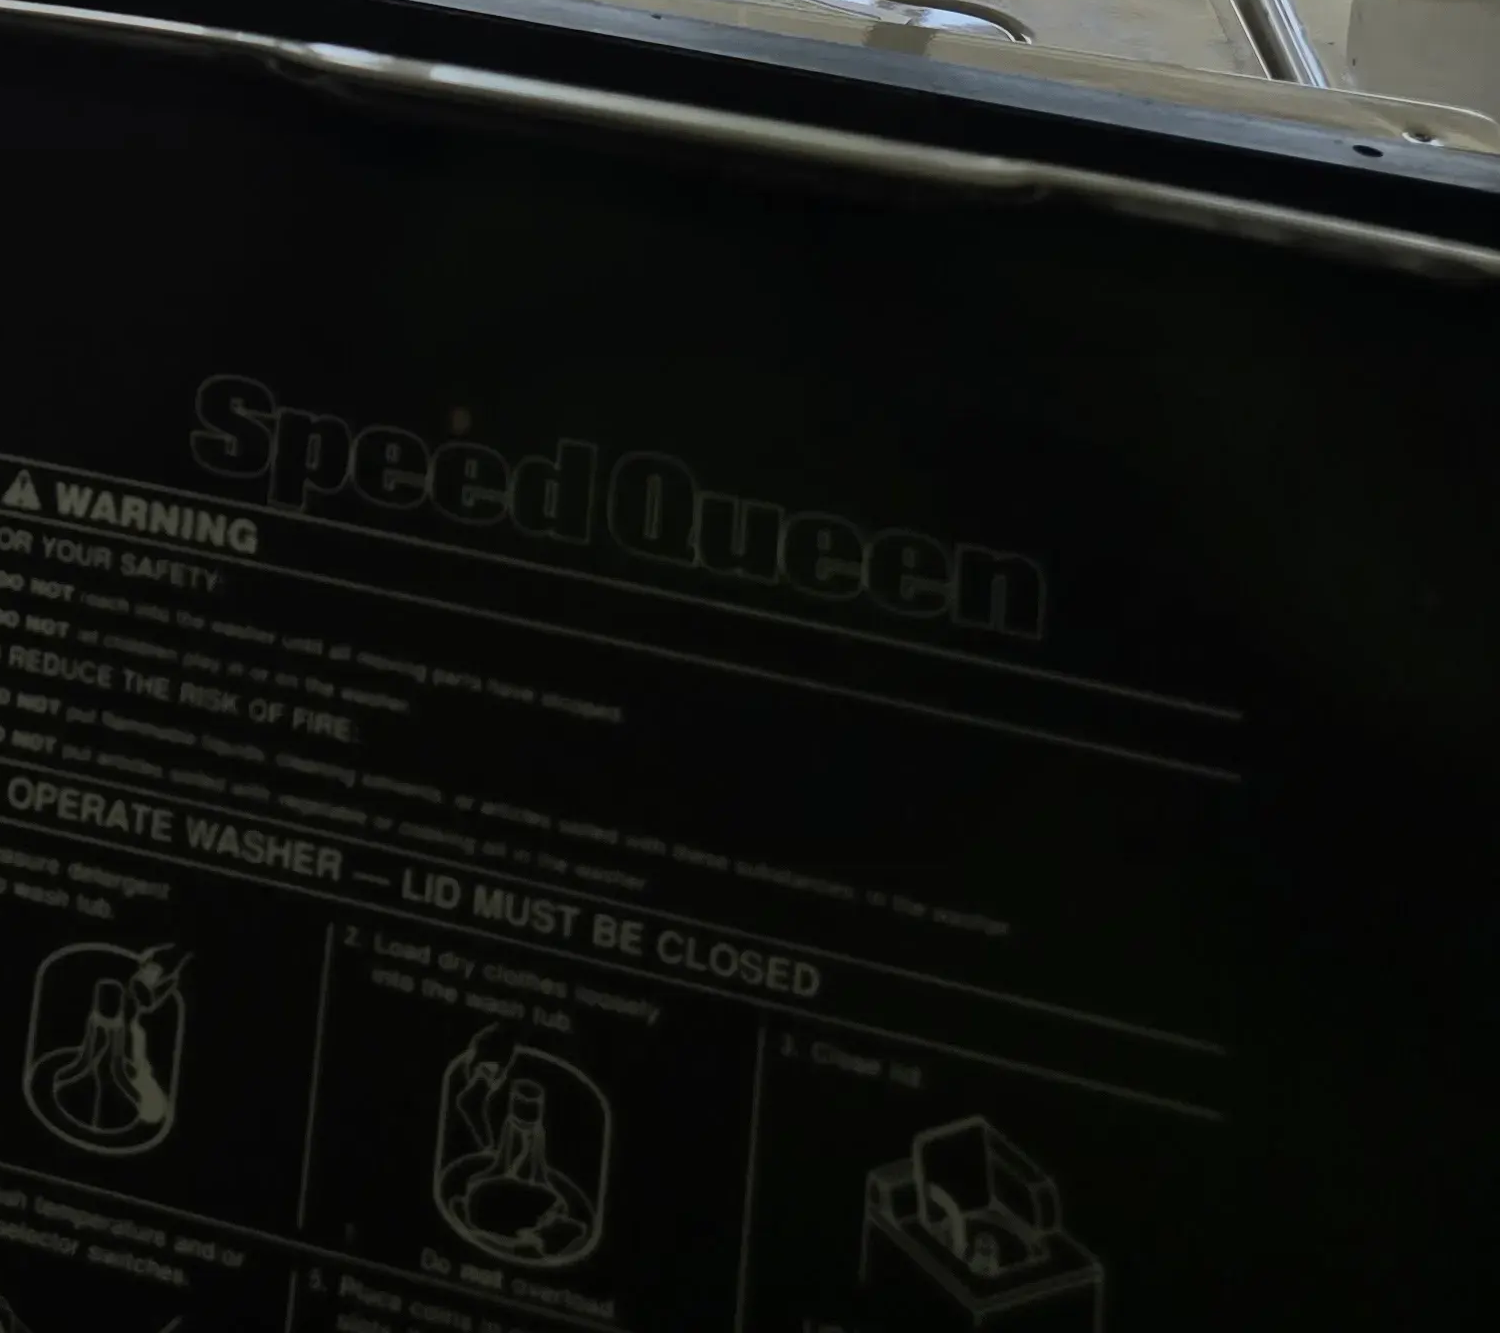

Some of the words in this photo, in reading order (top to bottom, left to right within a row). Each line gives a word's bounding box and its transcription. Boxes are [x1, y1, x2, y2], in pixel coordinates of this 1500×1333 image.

[41, 535, 113, 571] YOUR
[55, 480, 258, 555] WARNING
[8, 644, 114, 690] REDUCE
[122, 667, 173, 702] THE
[179, 681, 241, 717] RISK
[248, 697, 286, 724] OF
[7, 777, 174, 844] OPERATE
[186, 815, 343, 883] WASHER
[401, 867, 462, 911] LID
[473, 883, 581, 940] MUST
[593, 913, 645, 958] BE
[656, 929, 821, 999] CLOSED
